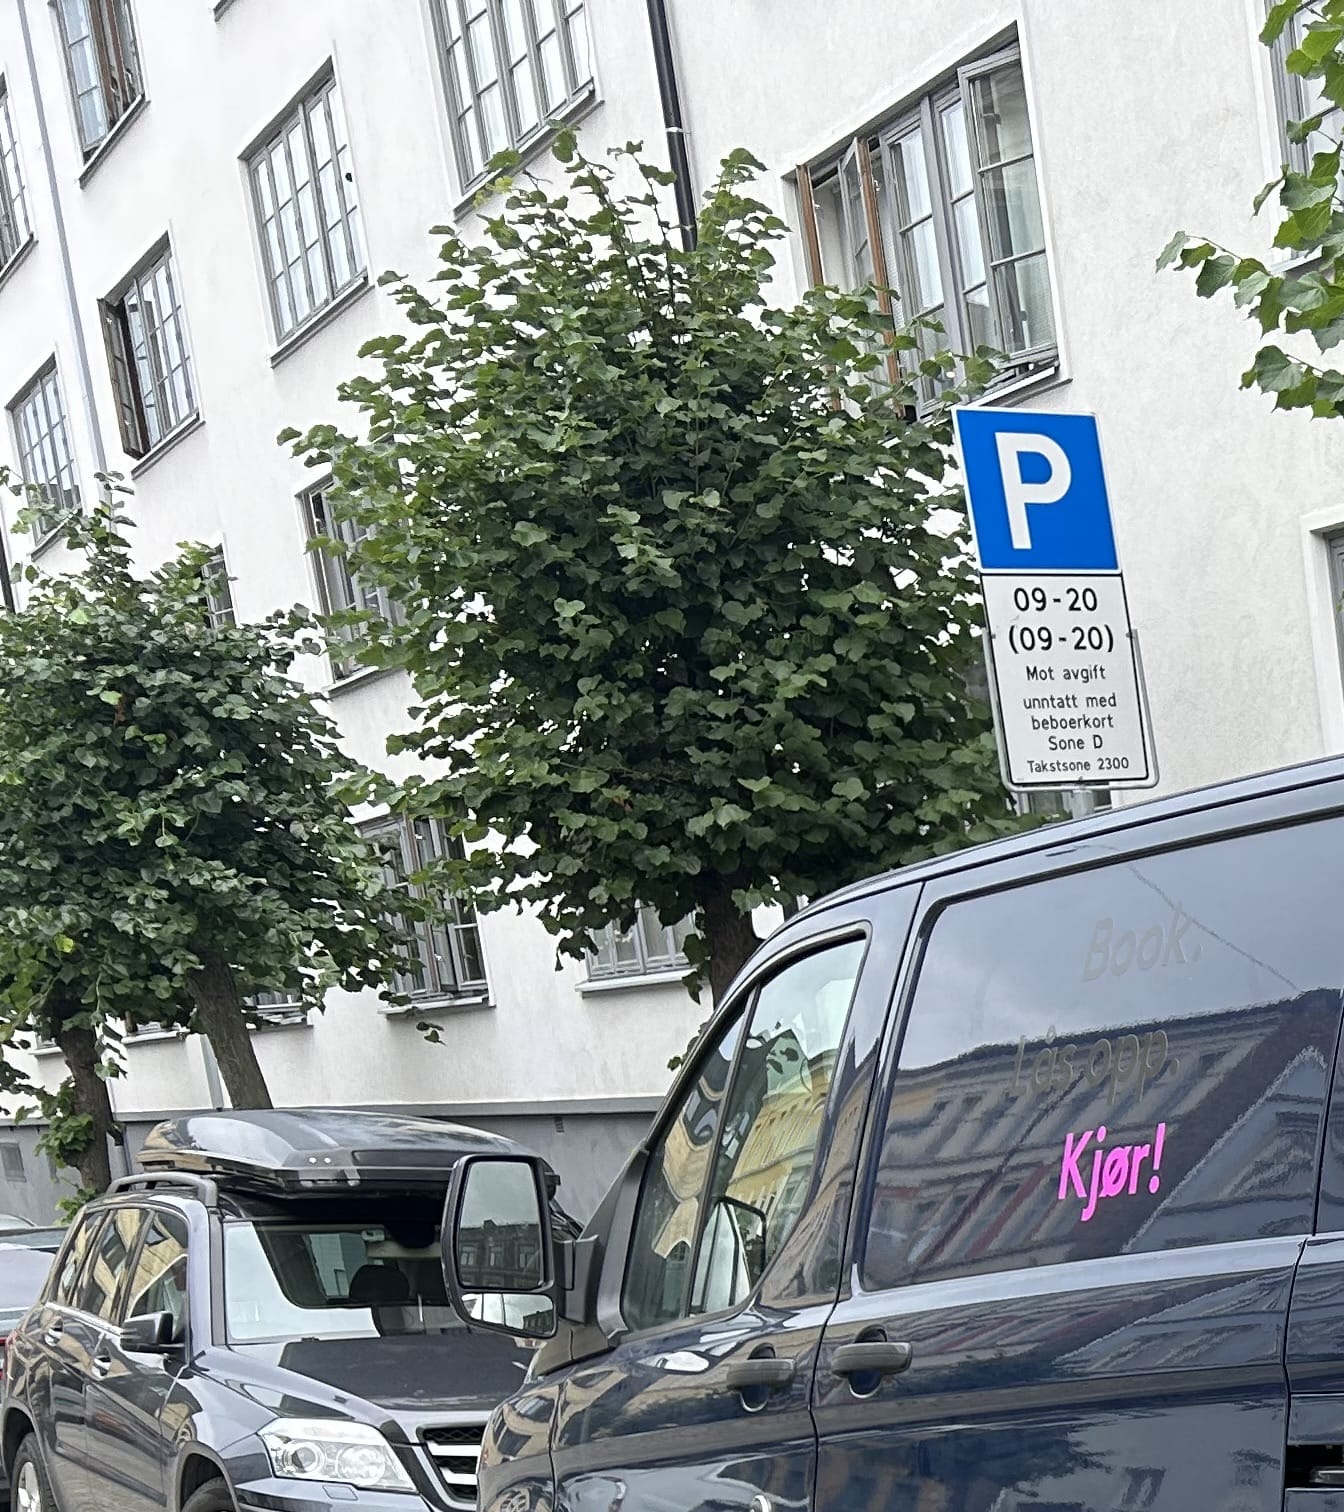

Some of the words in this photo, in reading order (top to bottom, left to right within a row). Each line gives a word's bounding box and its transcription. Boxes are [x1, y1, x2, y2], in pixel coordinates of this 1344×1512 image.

[994, 431, 1072, 550] P
[1026, 665, 1055, 681] Mot
[1062, 664, 1106, 684] avgift
[1023, 694, 1079, 710] unntatt
[1085, 692, 1117, 708] med
[1031, 713, 1114, 731] beboerkort
[1048, 735, 1085, 751] Sone
[1092, 734, 1103, 749] D
[1026, 759, 1091, 774] Takstsone
[1096, 756, 1129, 771] 2300
[1057, 1122, 1167, 1222] Kjør!
